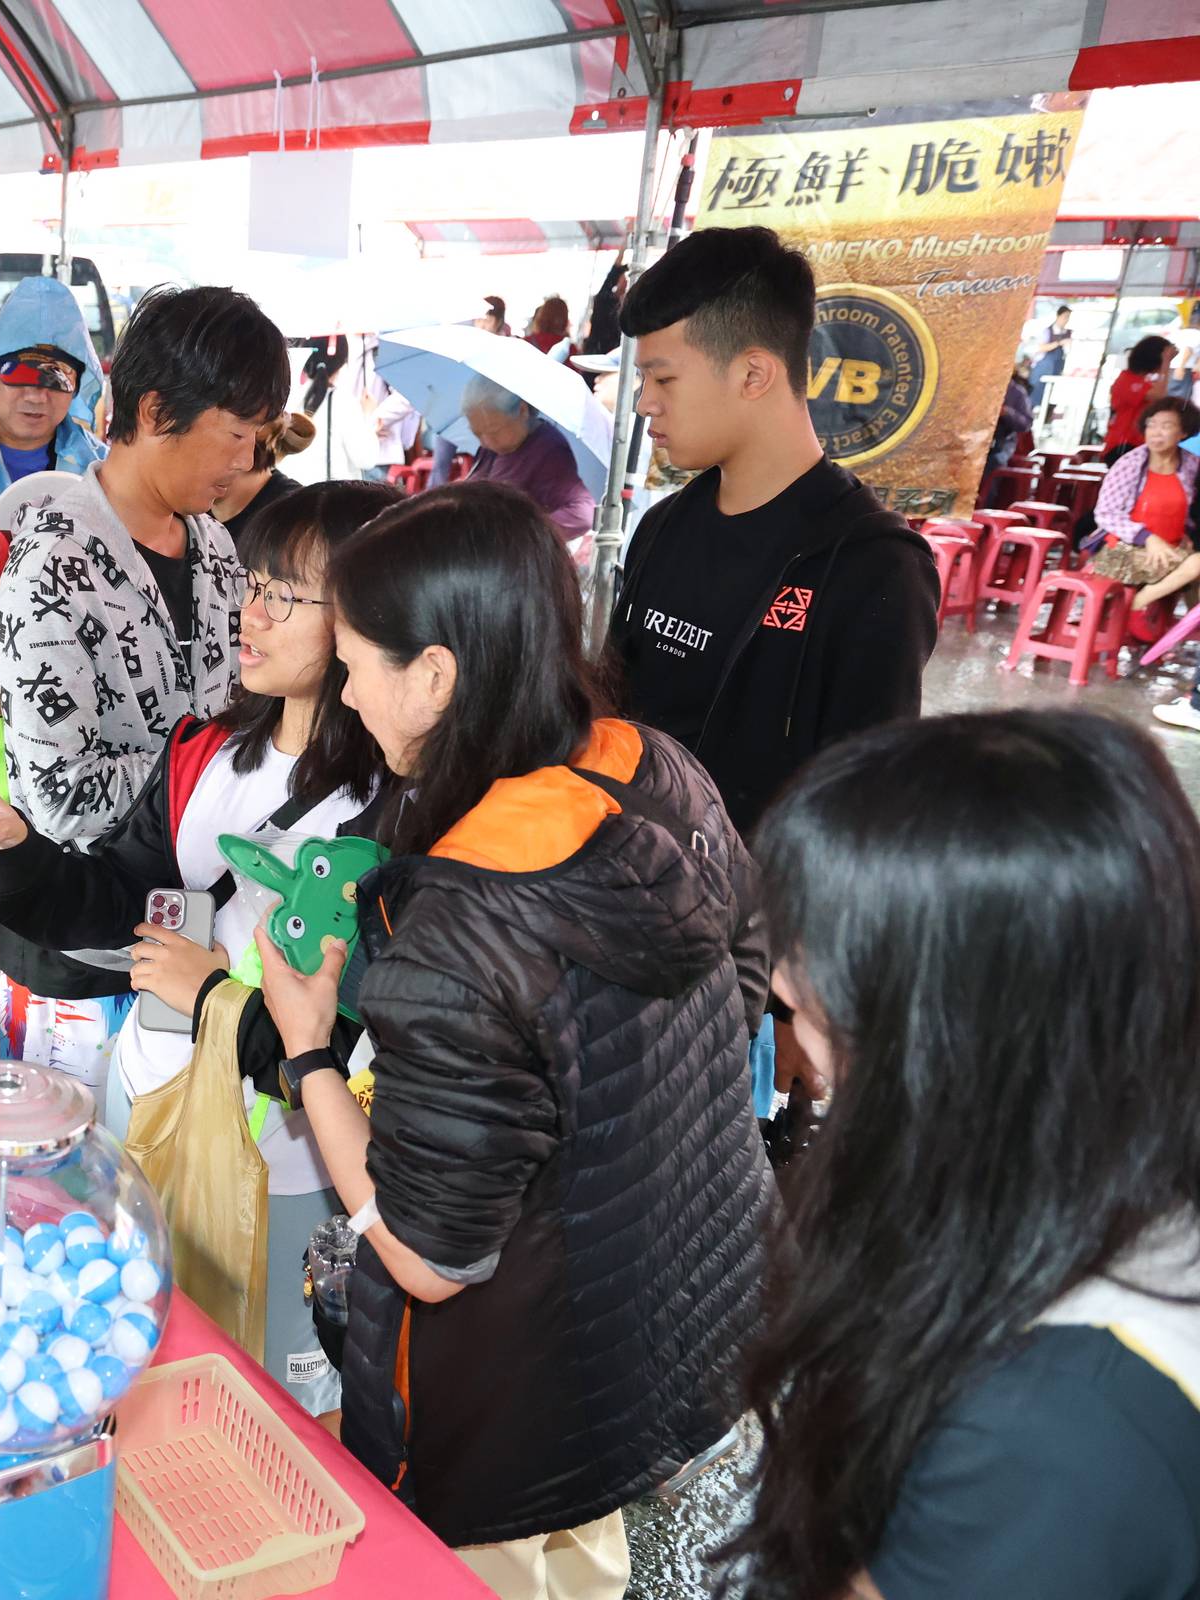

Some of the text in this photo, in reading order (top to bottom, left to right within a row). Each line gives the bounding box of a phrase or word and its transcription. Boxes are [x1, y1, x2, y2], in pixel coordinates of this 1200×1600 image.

[802, 232, 1050, 264] AMEKO Mushroom
[915, 268, 1032, 299] Taiwan
[881, 323, 913, 406] Patented
[29, 640, 60, 649] WRENCHES
[655, 641, 687, 658] LONDON
